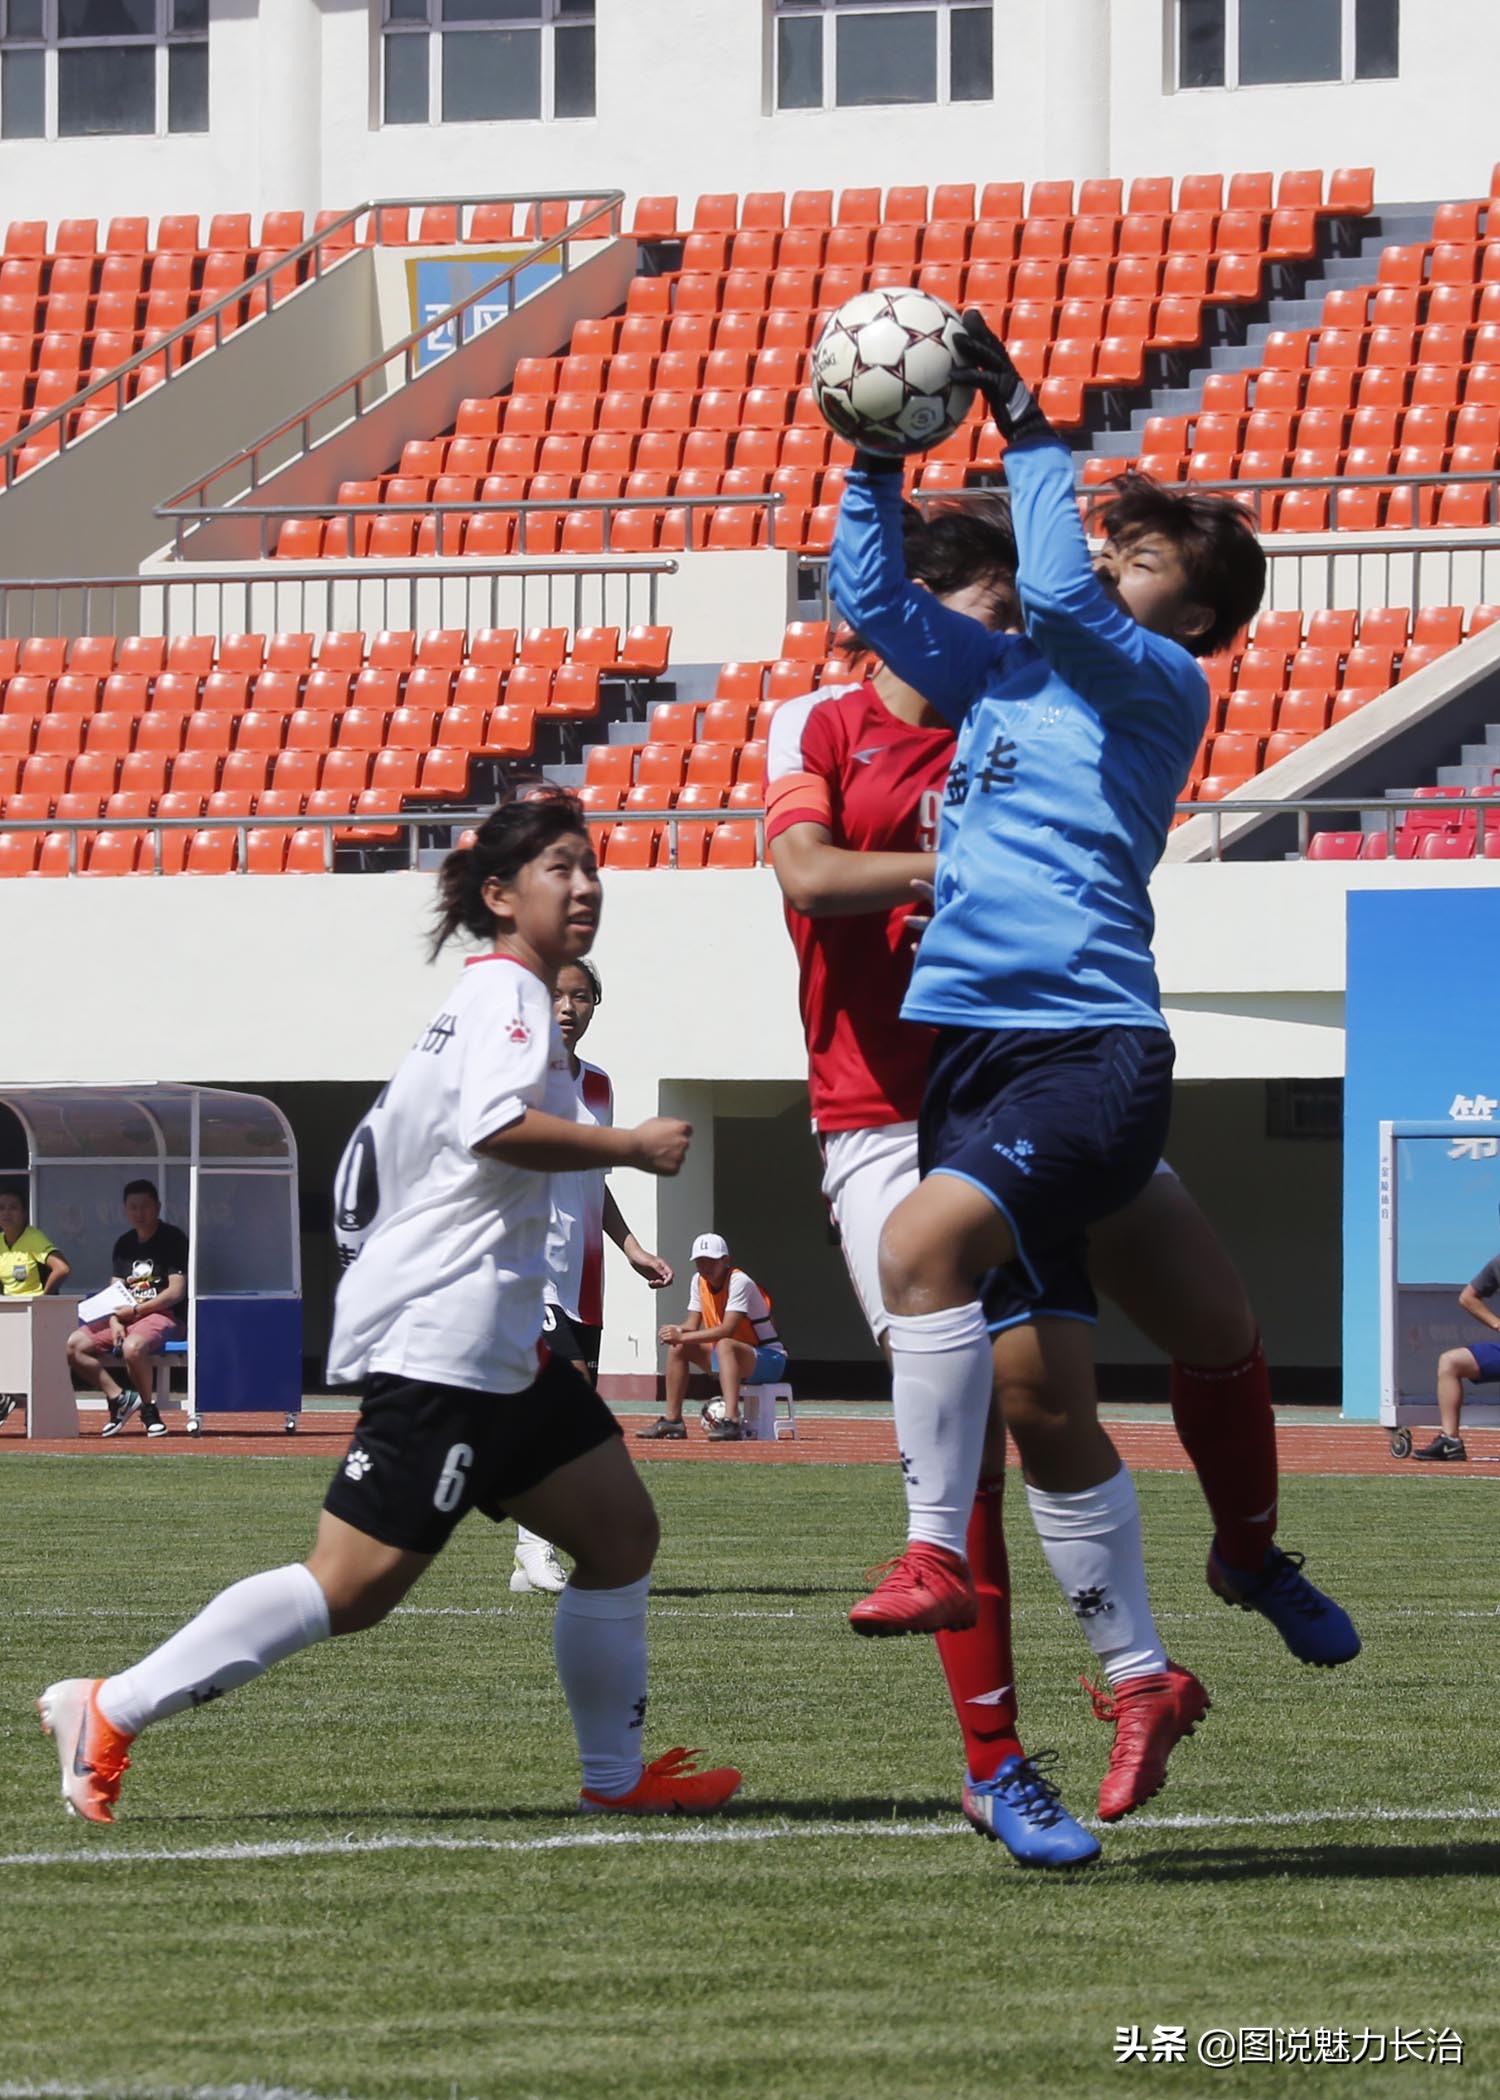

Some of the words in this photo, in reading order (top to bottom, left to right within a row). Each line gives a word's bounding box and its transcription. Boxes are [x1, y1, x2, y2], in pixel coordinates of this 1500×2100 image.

[992, 1142, 1032, 1176] KELME
[1446, 1093, 1499, 1161] 第
[433, 1442, 475, 1513] 6
